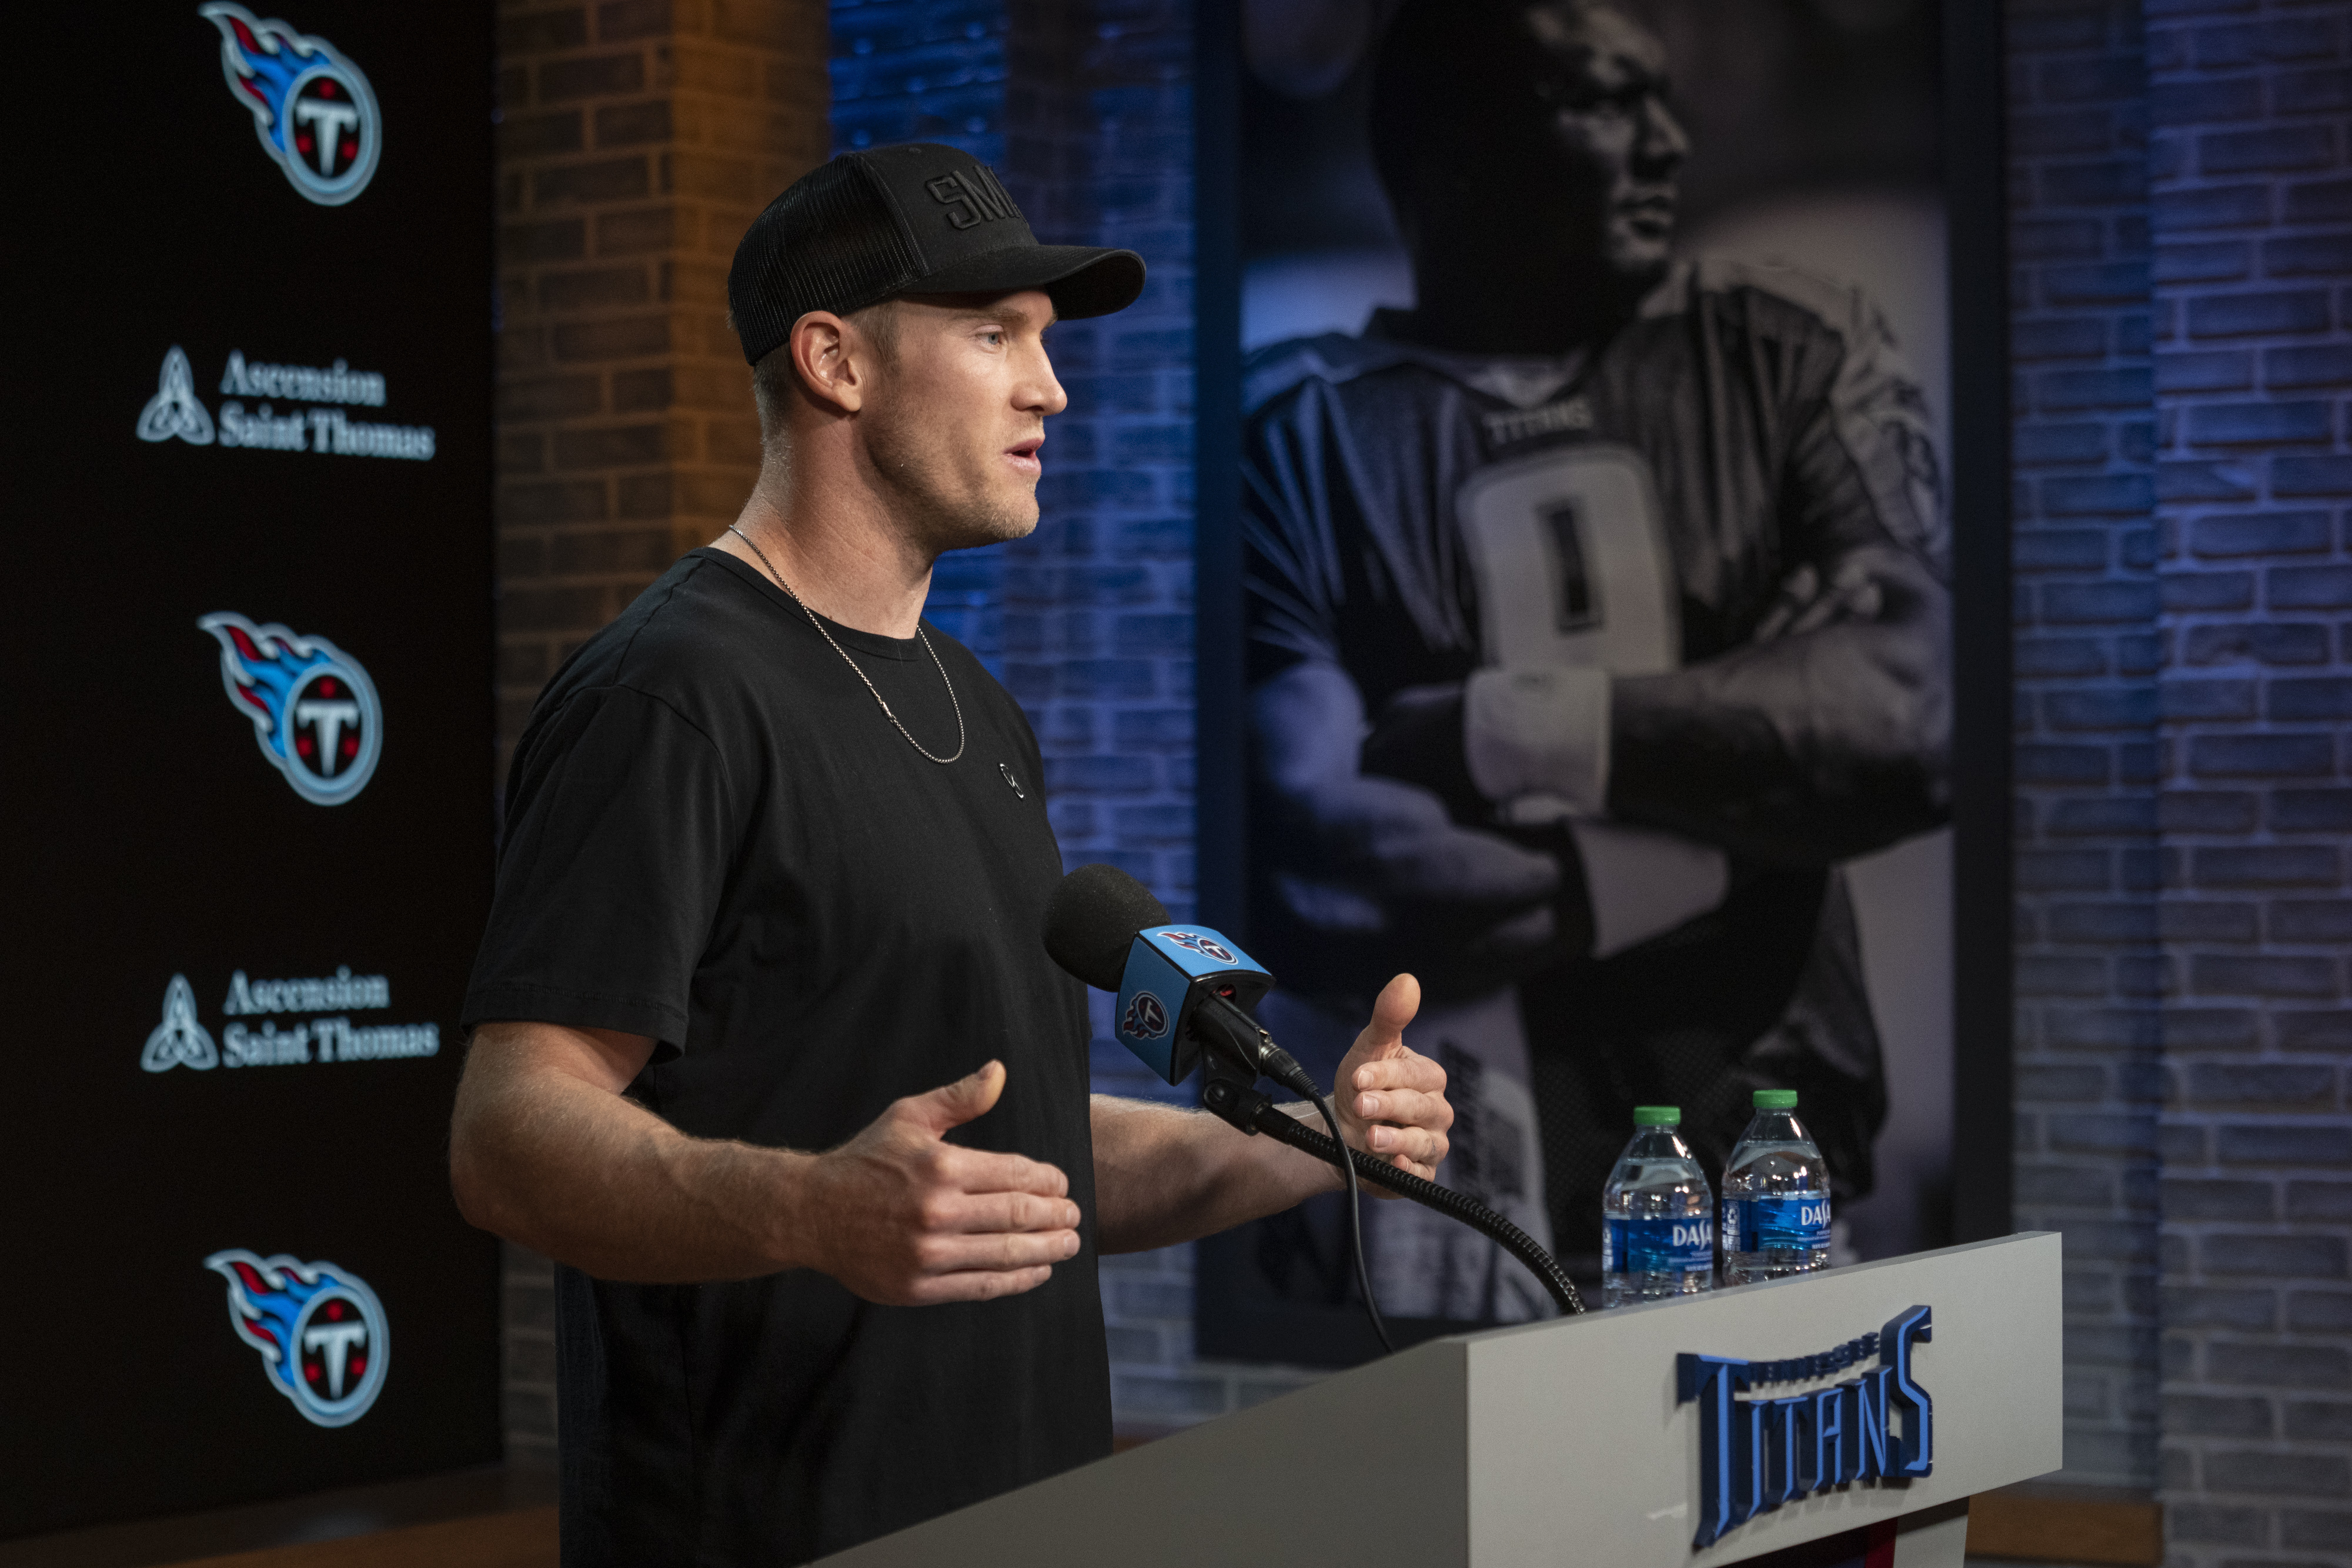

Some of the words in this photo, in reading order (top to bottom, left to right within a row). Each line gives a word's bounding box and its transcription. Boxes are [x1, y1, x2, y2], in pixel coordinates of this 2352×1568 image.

[220, 350, 386, 407] Ascension
[219, 400, 308, 452] Saint
[307, 408, 436, 460] Thomas
[222, 965, 390, 1015] Ascension
[222, 1019, 313, 1068] Saint
[311, 1016, 440, 1063] Thomas
[1677, 1305, 1933, 1552] TITANS
